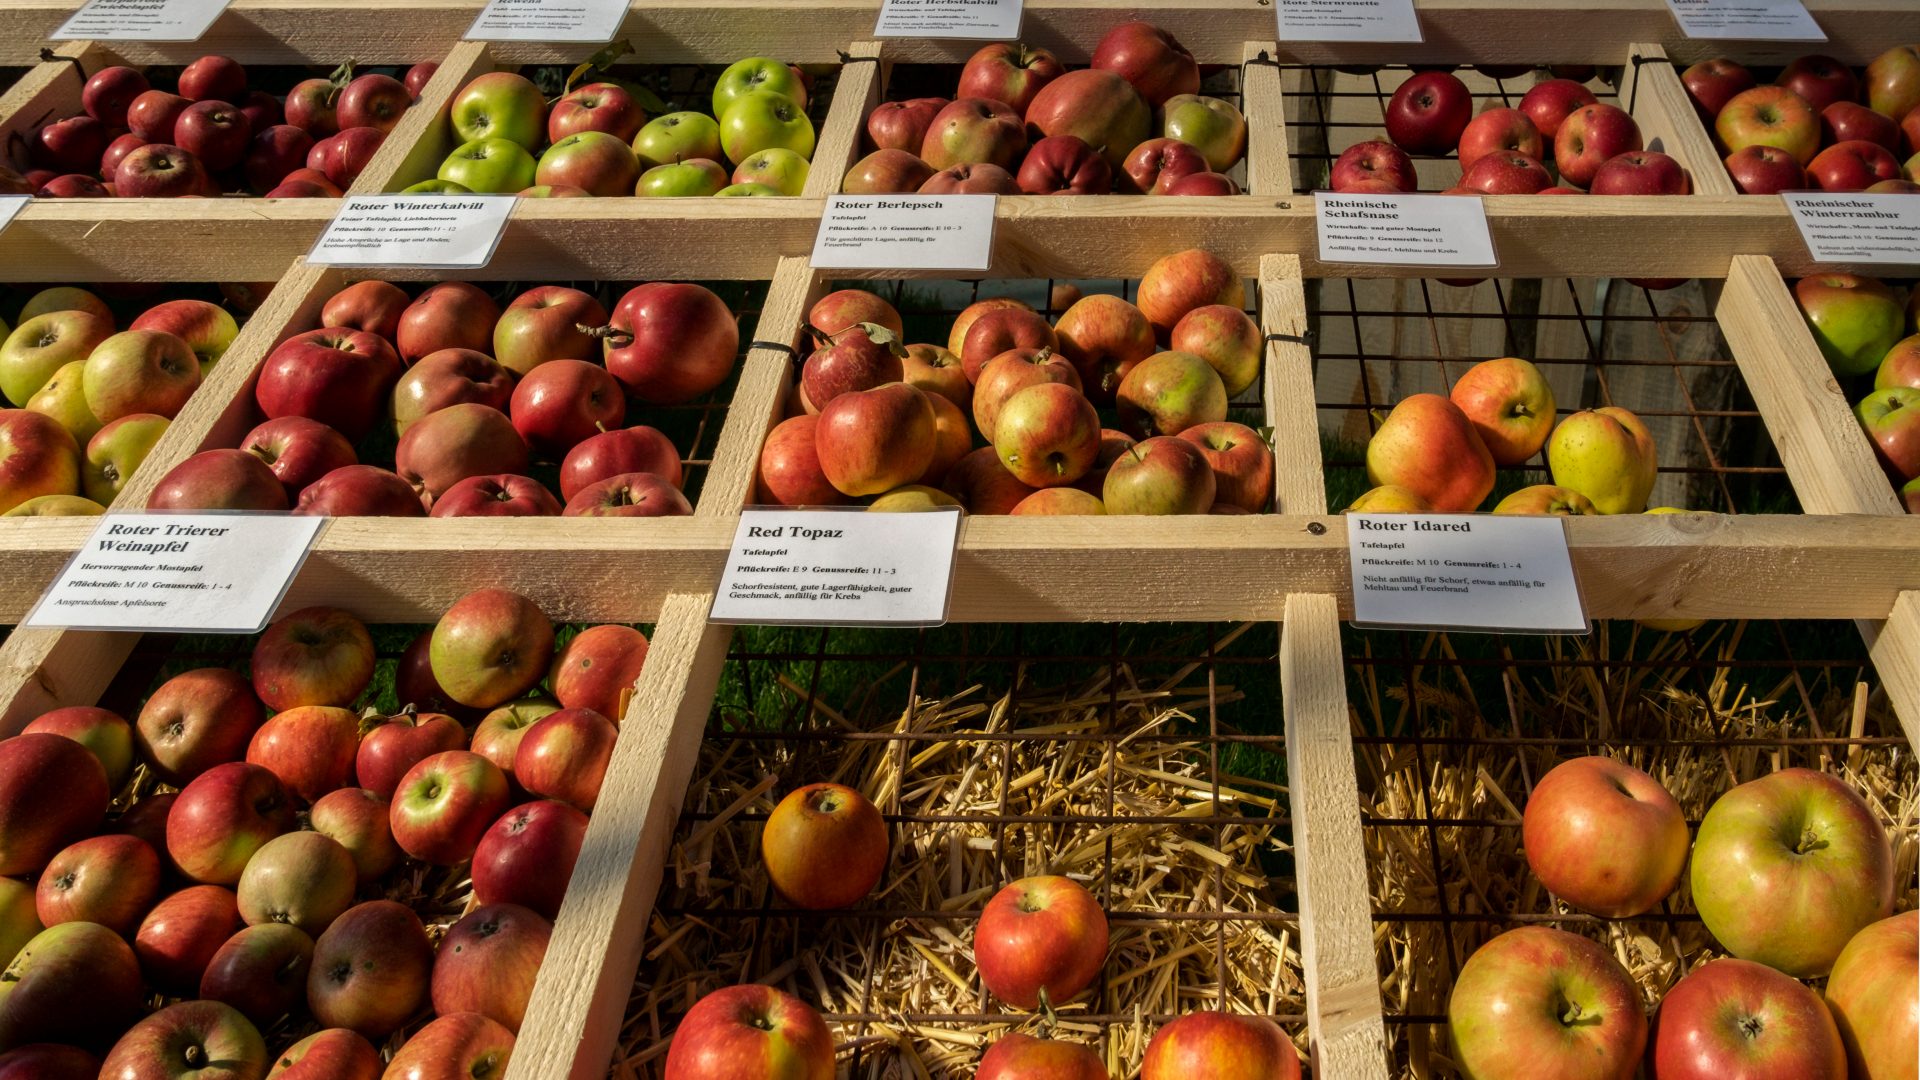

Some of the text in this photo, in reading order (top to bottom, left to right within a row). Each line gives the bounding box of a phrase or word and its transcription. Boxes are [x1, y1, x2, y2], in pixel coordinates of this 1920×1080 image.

[877, 202, 942, 210] Berlepsch
[1325, 211, 1398, 219] Schafsnase
[1800, 210, 1900, 218] Winterrambur
[1359, 520, 1471, 532] Roter Idared
[108, 525, 229, 536] Roter Trierer
[748, 527, 843, 540] Red Topaz
[100, 541, 189, 554] Weinapfel
[1360, 542, 1405, 550] Tafelapfel
[1444, 560, 1500, 568] Genussreife:
[157, 565, 203, 573] Mostapfel
[1389, 576, 1422, 584] anfällig
[1498, 580, 1531, 588] anfällig
[822, 584, 887, 594] Lagerfähigkeit,
[784, 592, 817, 600] anfällig
